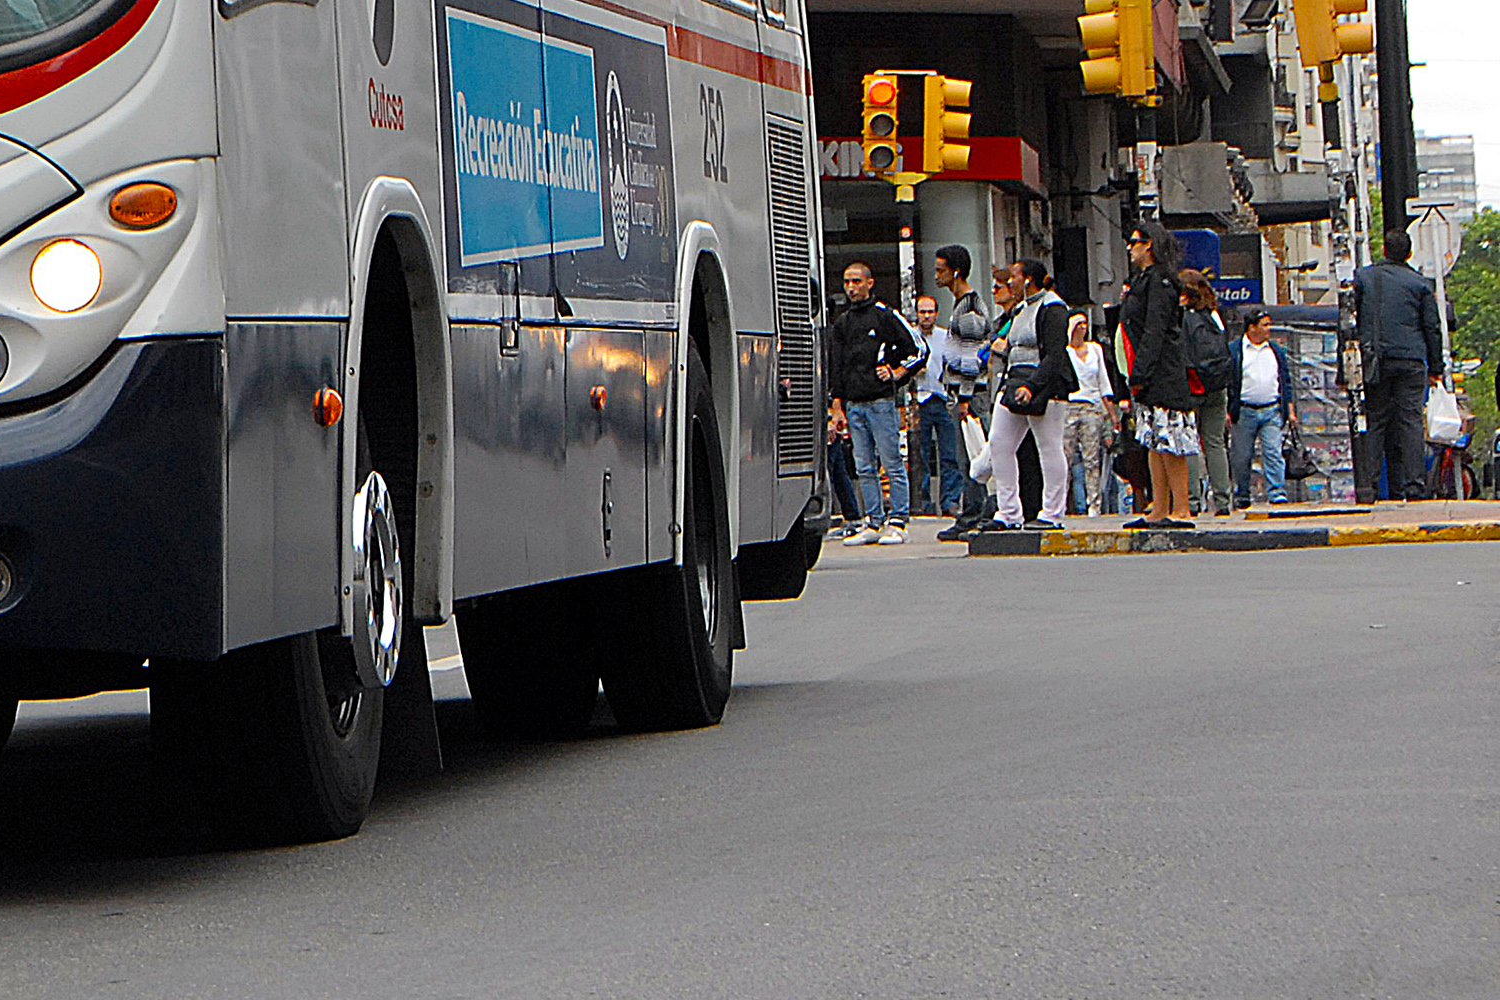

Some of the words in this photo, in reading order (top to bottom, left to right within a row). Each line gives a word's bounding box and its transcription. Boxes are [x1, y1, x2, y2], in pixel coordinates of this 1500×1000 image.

[457, 90, 533, 184] Recreación
[533, 107, 597, 192] Educativa
[699, 82, 728, 183] 252
